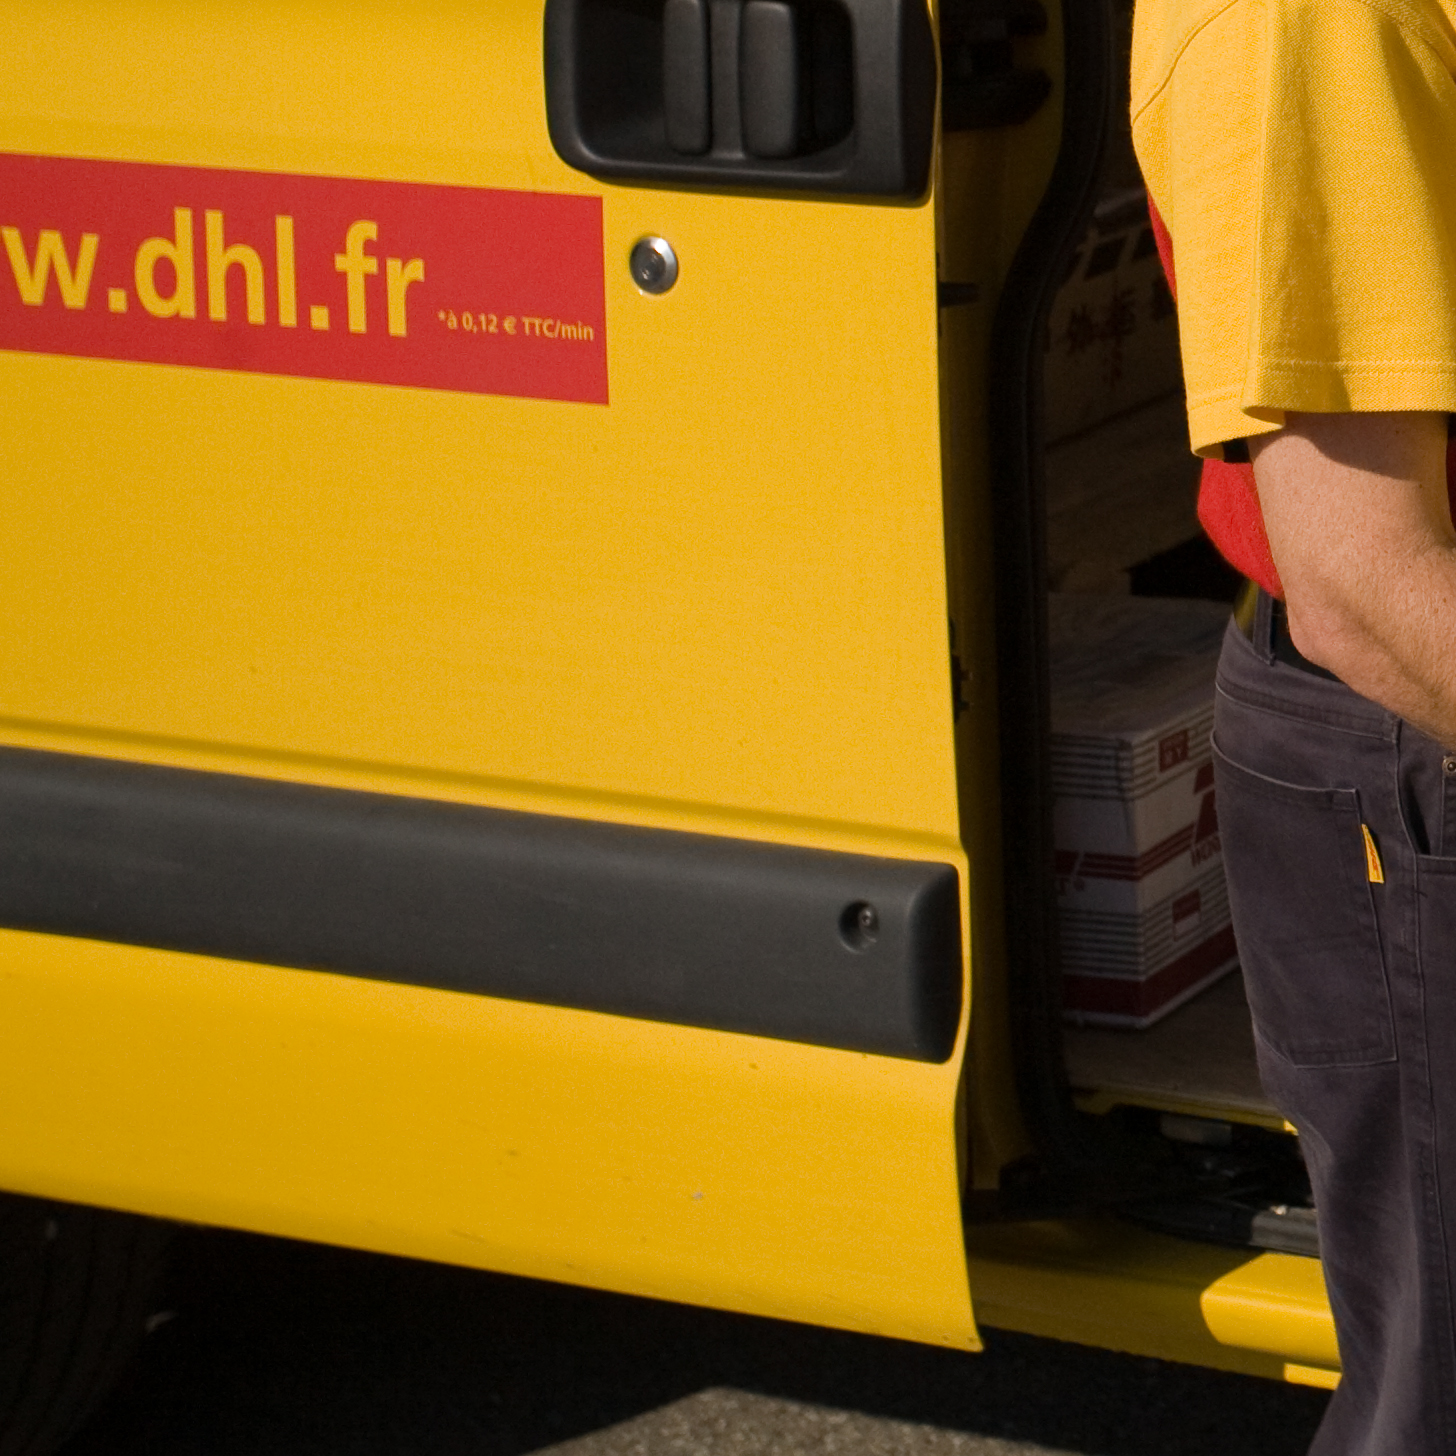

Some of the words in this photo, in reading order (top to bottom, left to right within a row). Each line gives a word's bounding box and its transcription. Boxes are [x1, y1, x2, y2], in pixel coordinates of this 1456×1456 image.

[461, 311, 499, 334] 0,12
[502, 315, 517, 335] €
[521, 315, 595, 342] TTC/min
